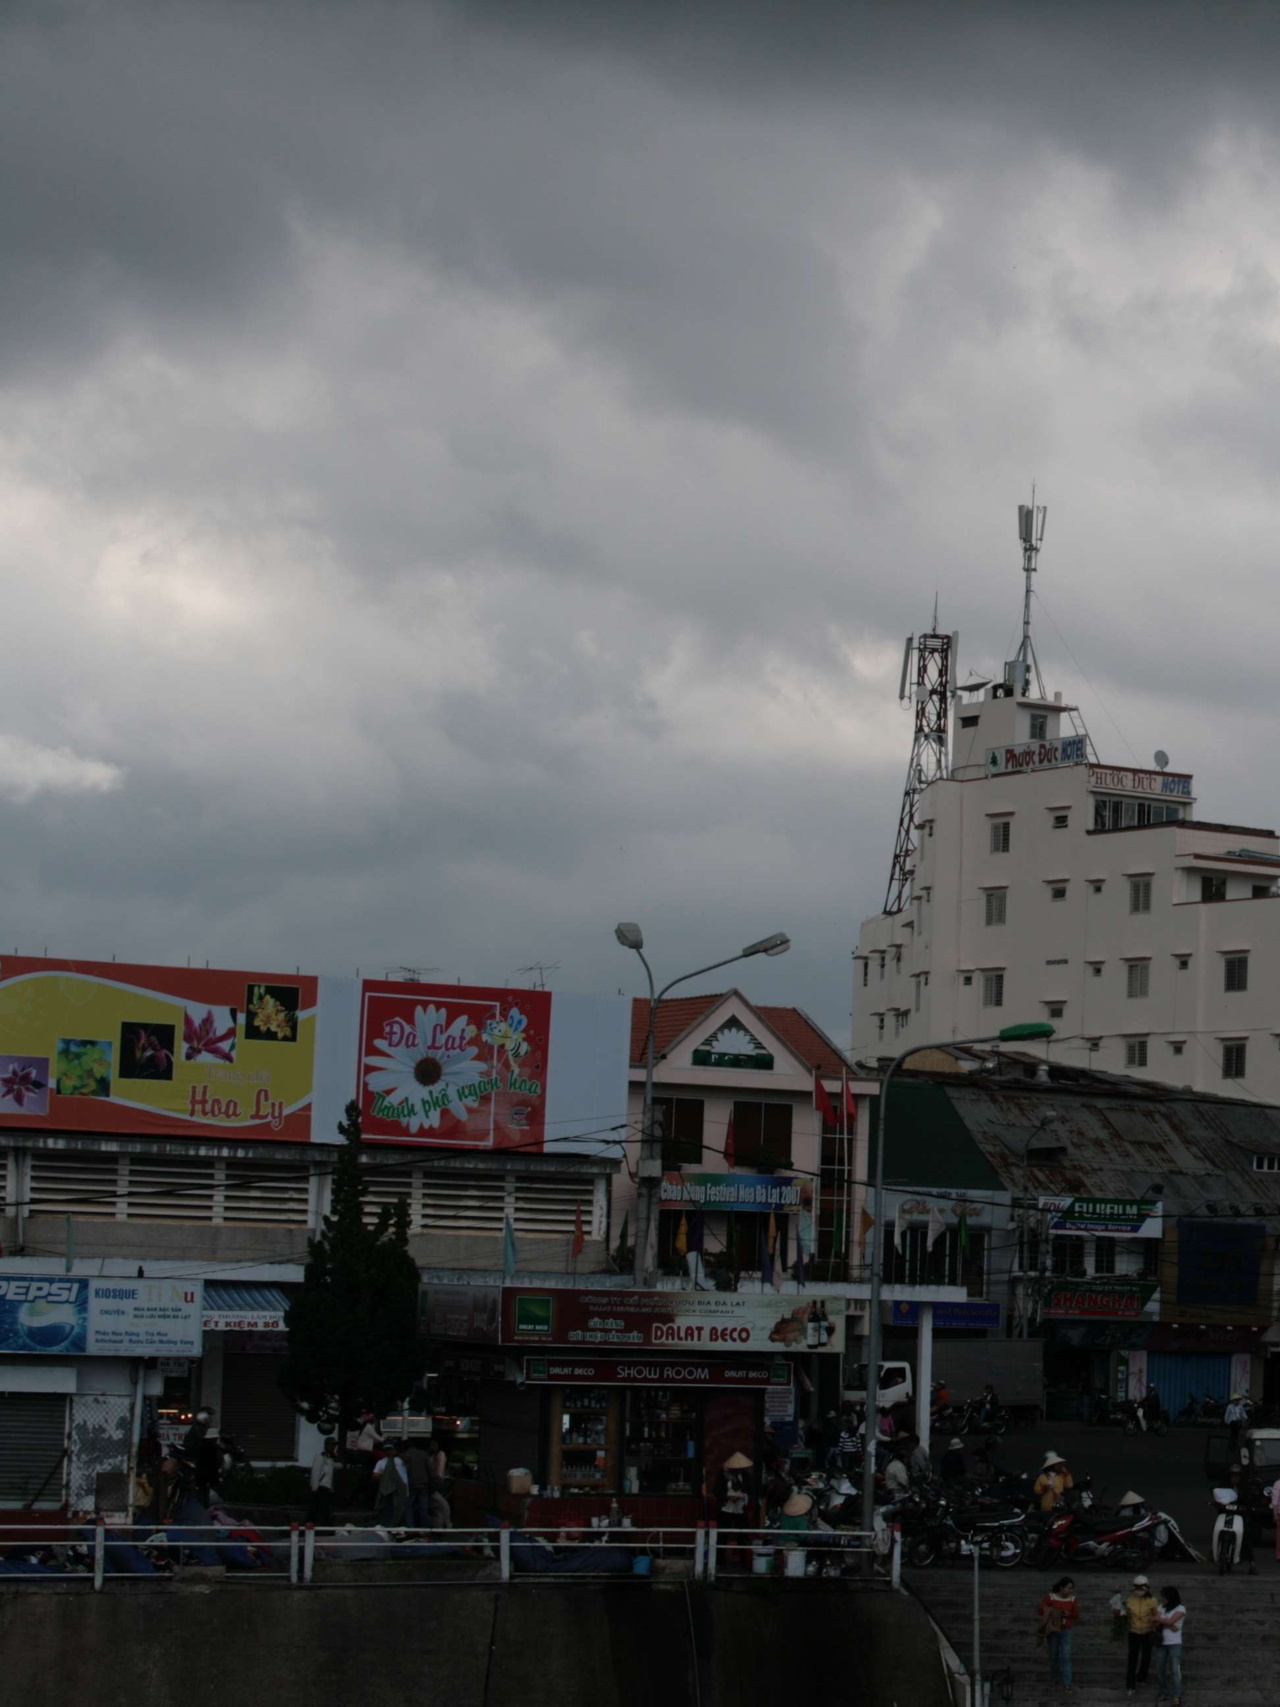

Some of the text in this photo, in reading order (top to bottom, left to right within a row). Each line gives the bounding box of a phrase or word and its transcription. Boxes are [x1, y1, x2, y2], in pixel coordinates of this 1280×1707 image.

[1061, 738, 1084, 761] HOTEL
[1161, 777, 1191, 796] HOTEL
[427, 1023, 470, 1059] Lạt
[370, 1069, 542, 1121] Thành phố ngàn hoa
[188, 1084, 285, 1131] Hoa Ly
[706, 1182, 738, 1202] Festival
[739, 1184, 754, 1202] Hoa
[781, 1185, 801, 1205] 2007
[1074, 1202, 1138, 1219] FUJIFILM
[1107, 1223, 1132, 1232] Service
[94, 1288, 138, 1301] KIOSQUE
[1052, 1291, 1142, 1309] SHANGHAI
[224, 1319, 258, 1330] KIỆM
[652, 1323, 752, 1343] DALAT BECO
[549, 1365, 769, 1380] DALAT BECO SHOW ROOM DALAT BECO
